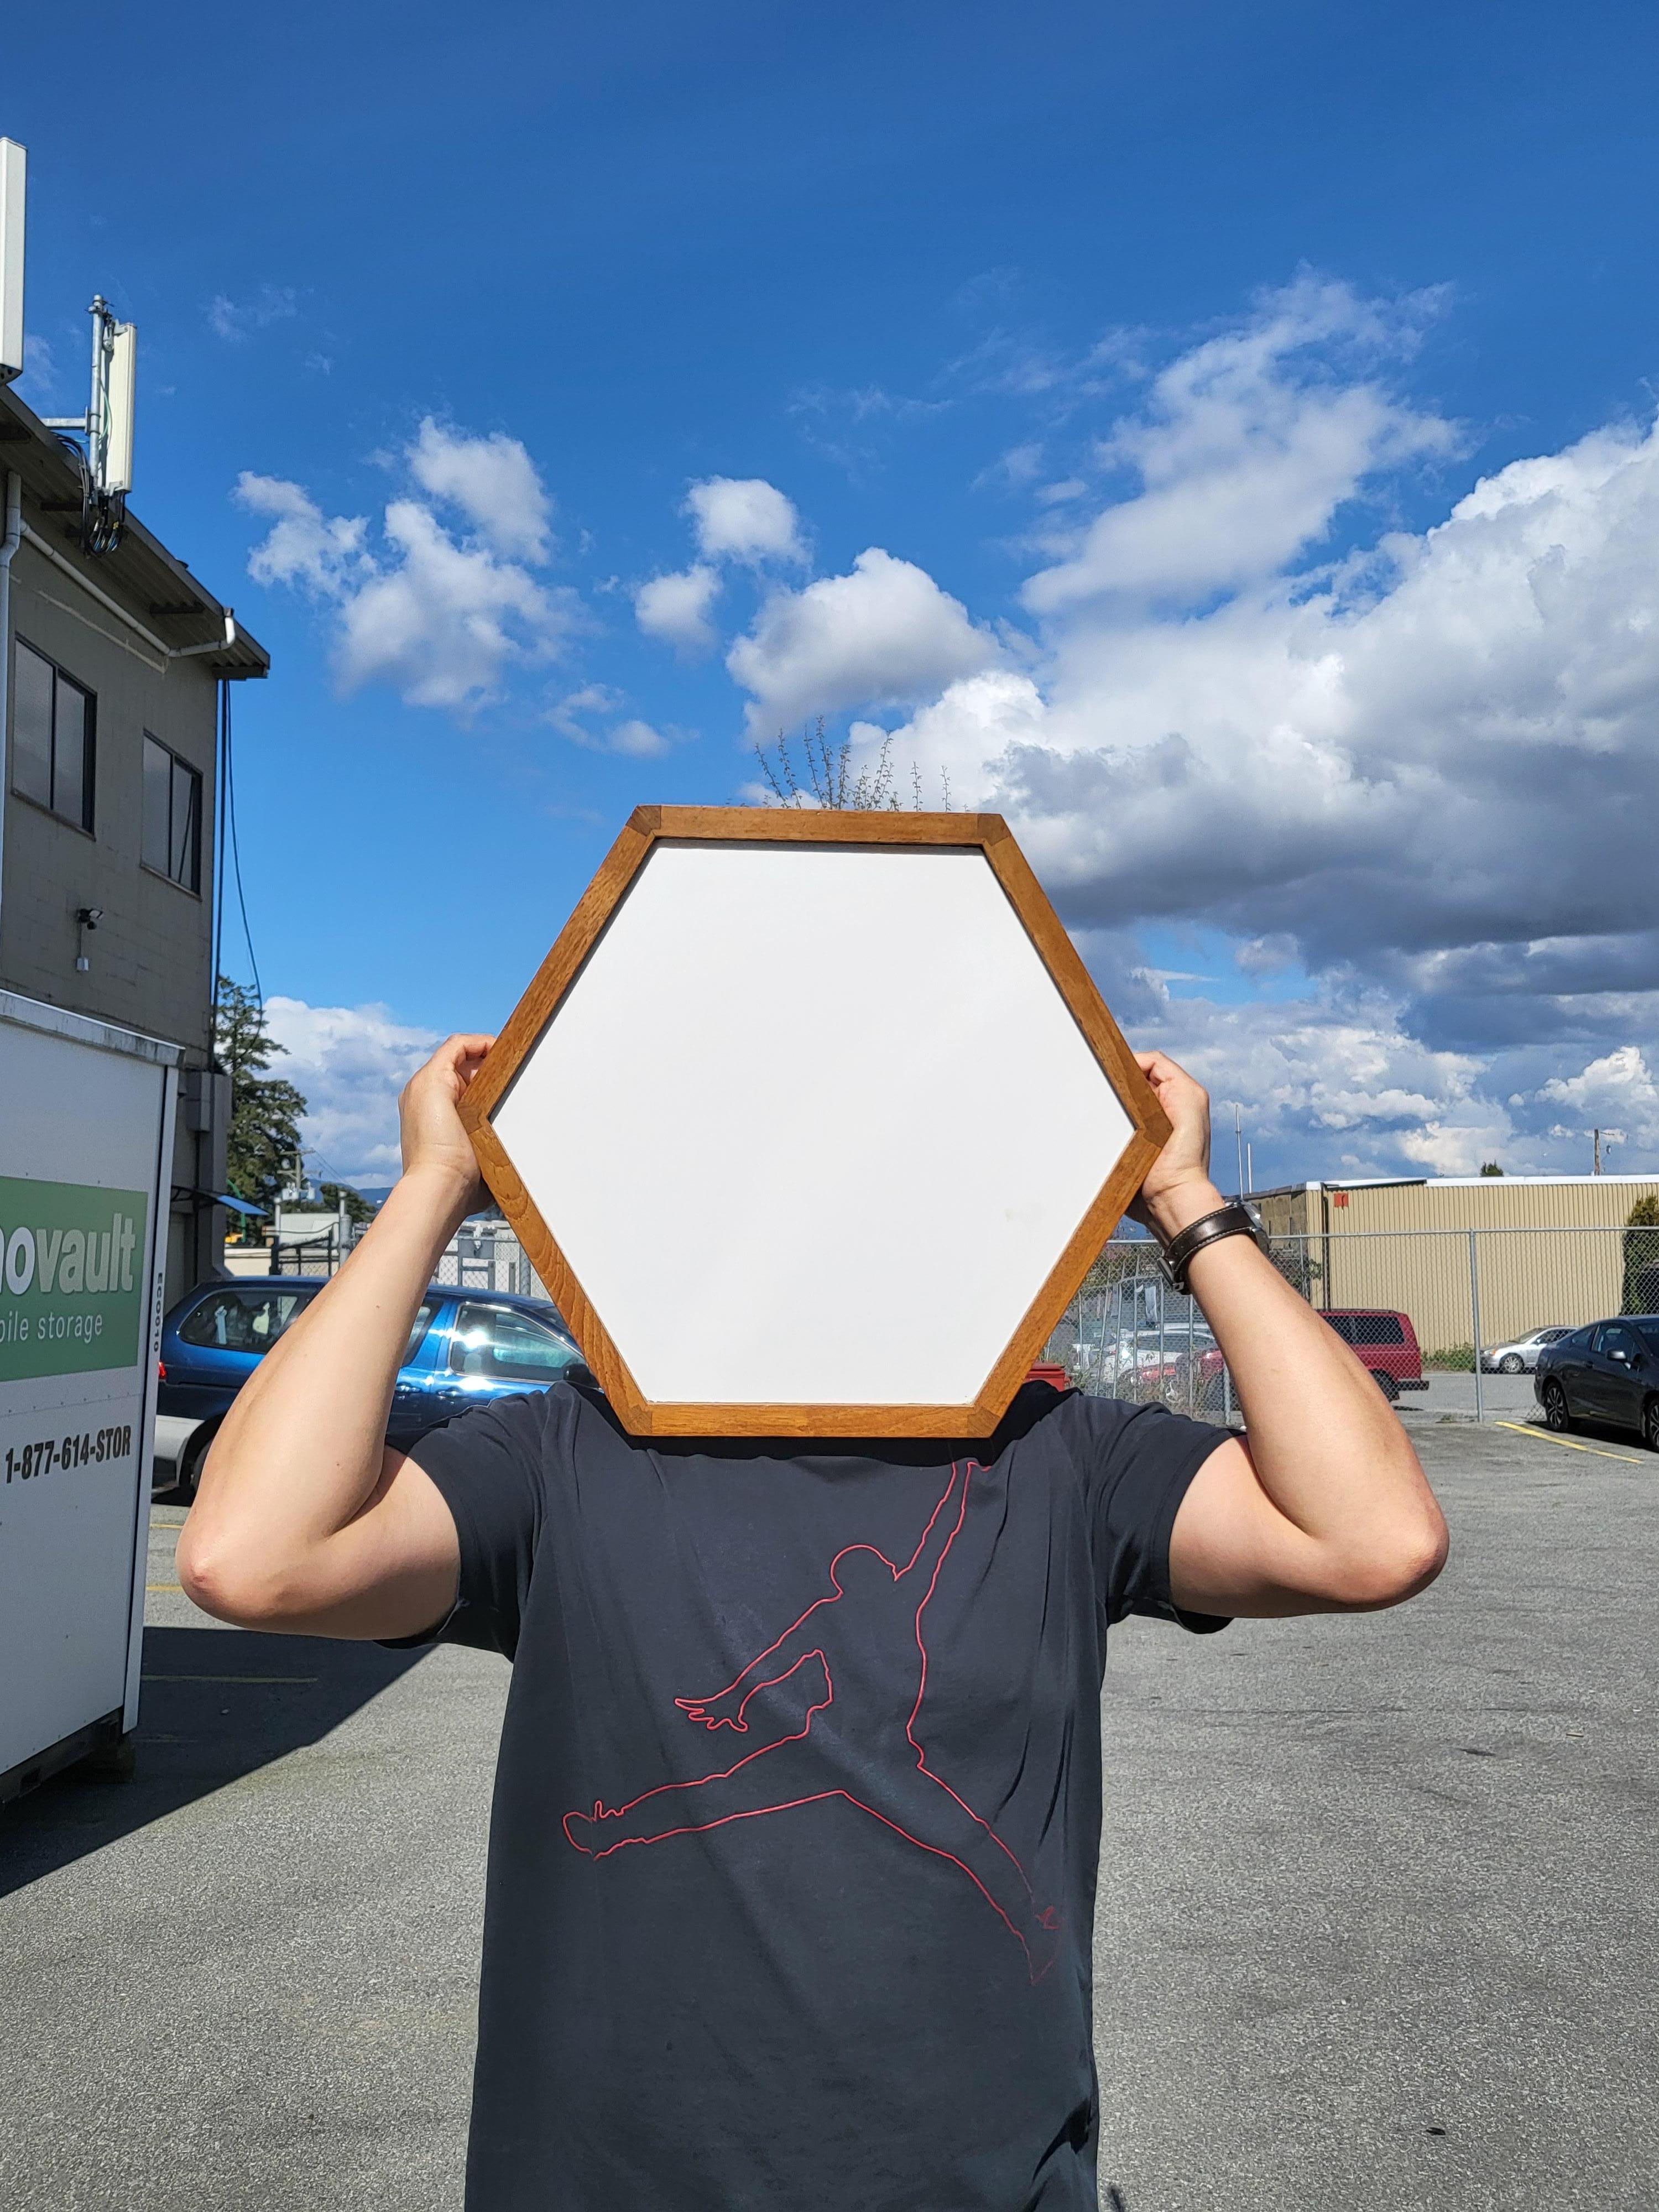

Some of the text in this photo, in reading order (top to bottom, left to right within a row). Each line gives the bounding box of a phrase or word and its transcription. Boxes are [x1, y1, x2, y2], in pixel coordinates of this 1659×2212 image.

[0, 1213, 136, 1295] ovault
[37, 1311, 103, 1344] storage
[6, 1425, 131, 1484] 1-877-614-STOR
